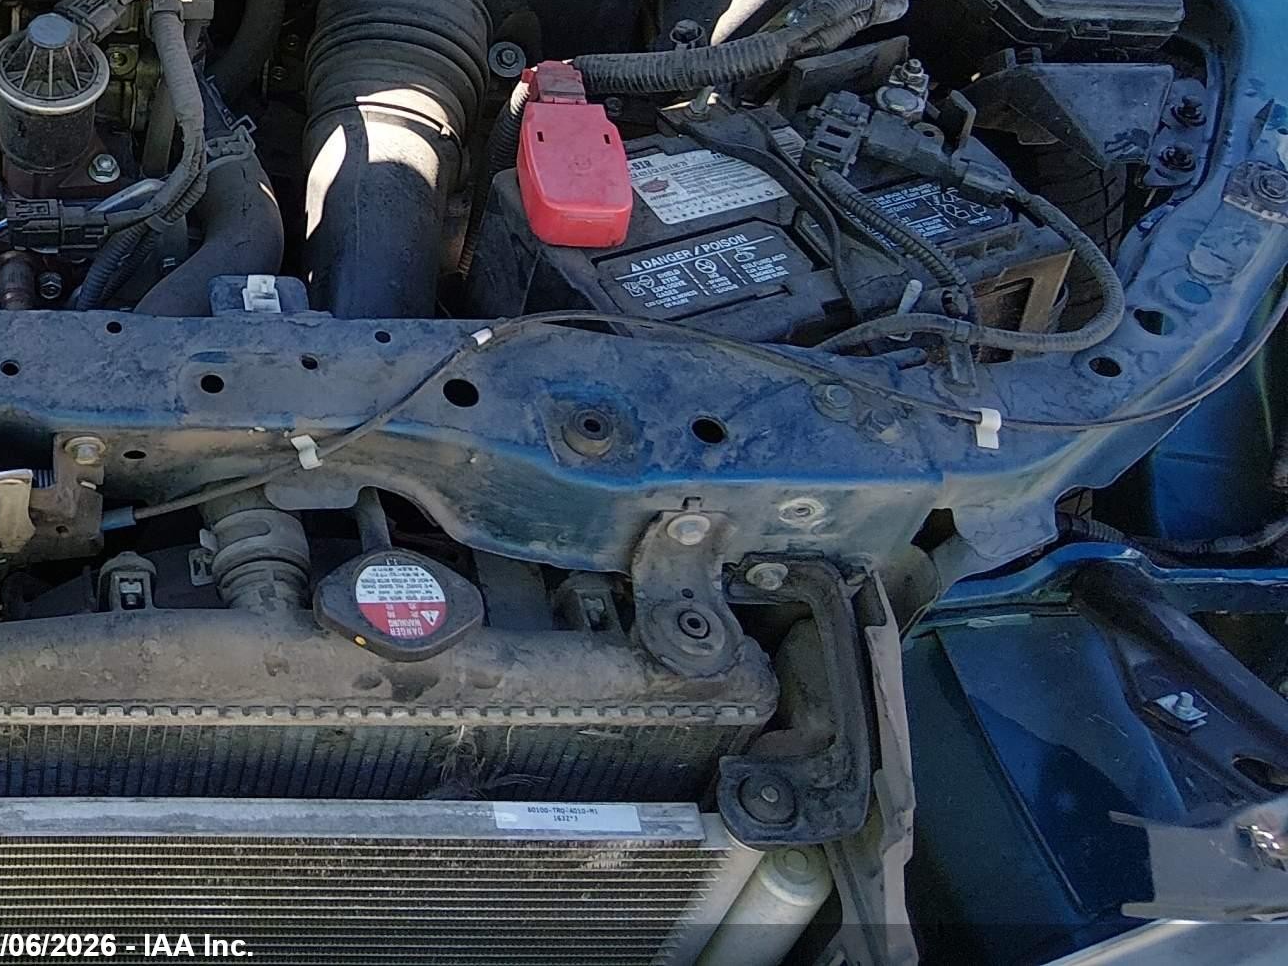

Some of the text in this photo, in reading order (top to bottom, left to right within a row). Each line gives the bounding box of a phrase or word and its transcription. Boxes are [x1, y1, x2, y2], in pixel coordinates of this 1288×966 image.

[641, 250, 693, 269] DANGER
[700, 234, 748, 253] POISON
[389, 627, 425, 636] DANGER
